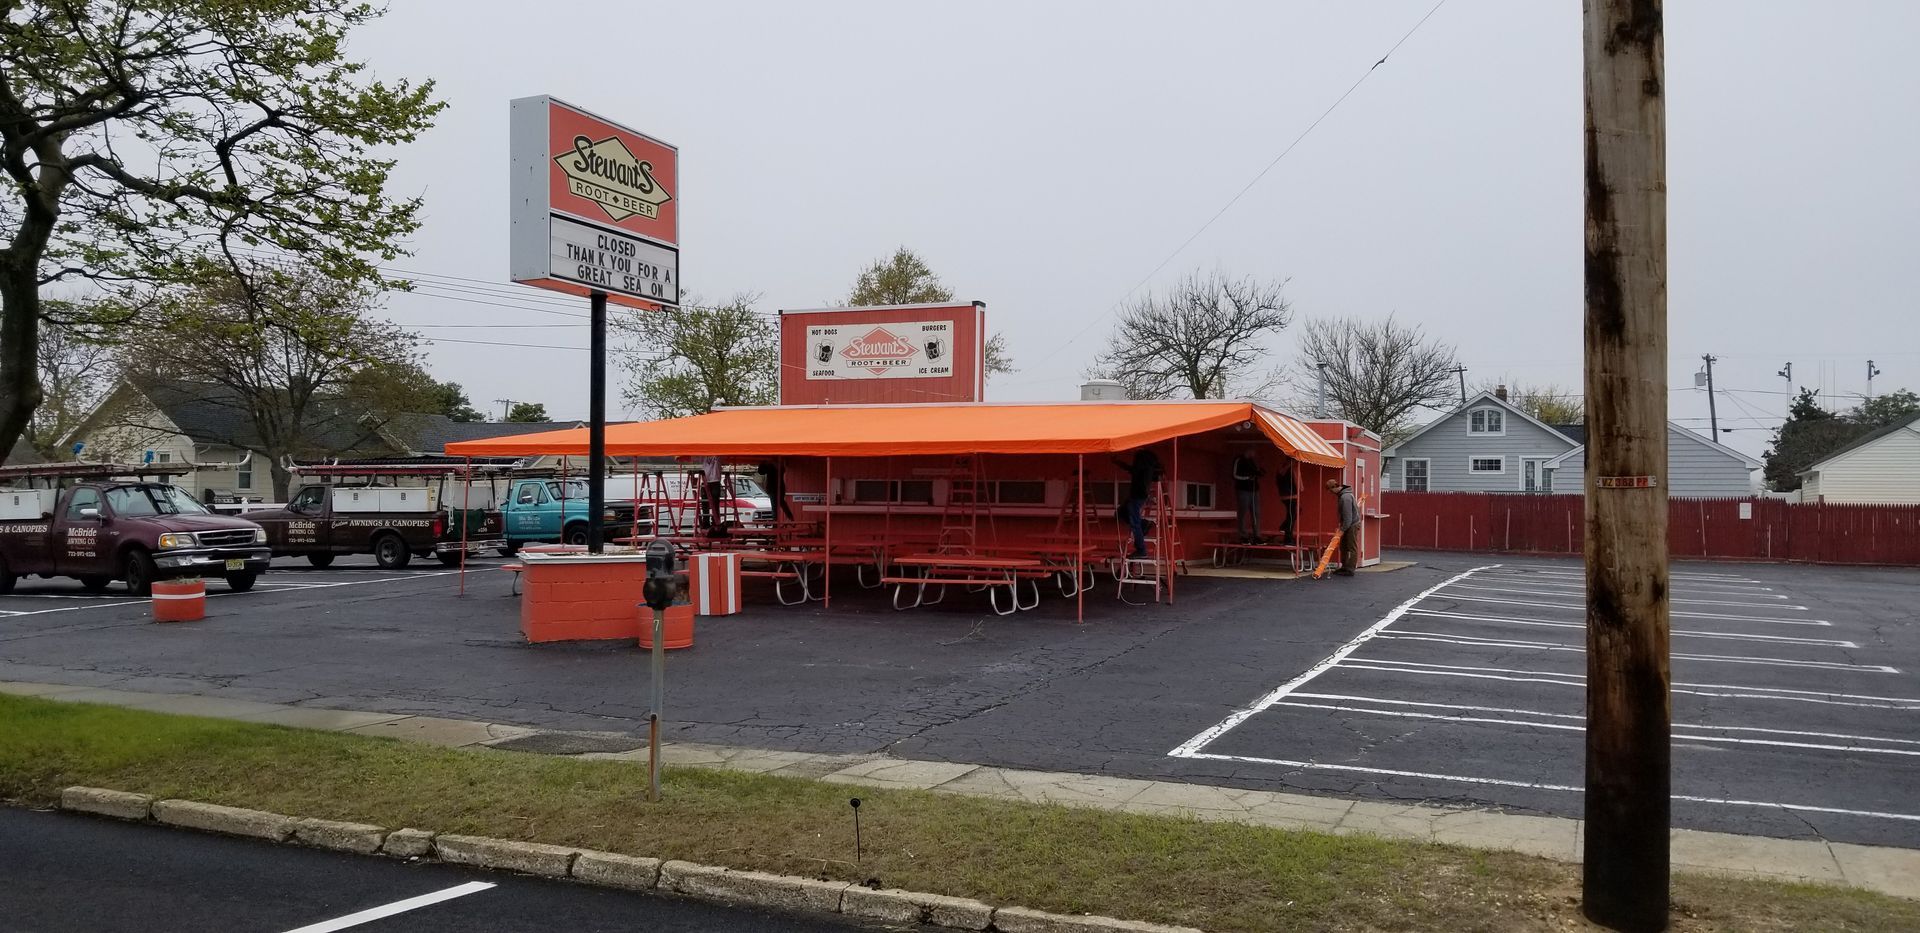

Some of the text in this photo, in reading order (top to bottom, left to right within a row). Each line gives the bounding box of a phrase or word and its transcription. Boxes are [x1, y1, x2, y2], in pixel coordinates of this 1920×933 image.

[576, 182, 653, 216] ROOT BEER
[598, 234, 636, 257] CLOSED
[610, 255, 631, 272] YOU
[638, 262, 658, 280] FOR
[665, 270, 671, 283] A
[578, 265, 663, 297] GREAT SEA ON
[922, 324, 947, 332] BURGERS
[812, 369, 835, 377] SEAFOOD
[930, 366, 949, 374] CREAM
[288, 521, 316, 529] McBride
[349, 519, 383, 527] AWNINGS
[391, 519, 430, 527] CANOPIES
[12, 525, 48, 533] CANOPIES
[67, 527, 97, 537] McBride
[67, 537, 87, 545] AWNING
[653, 619, 660, 632] 7
